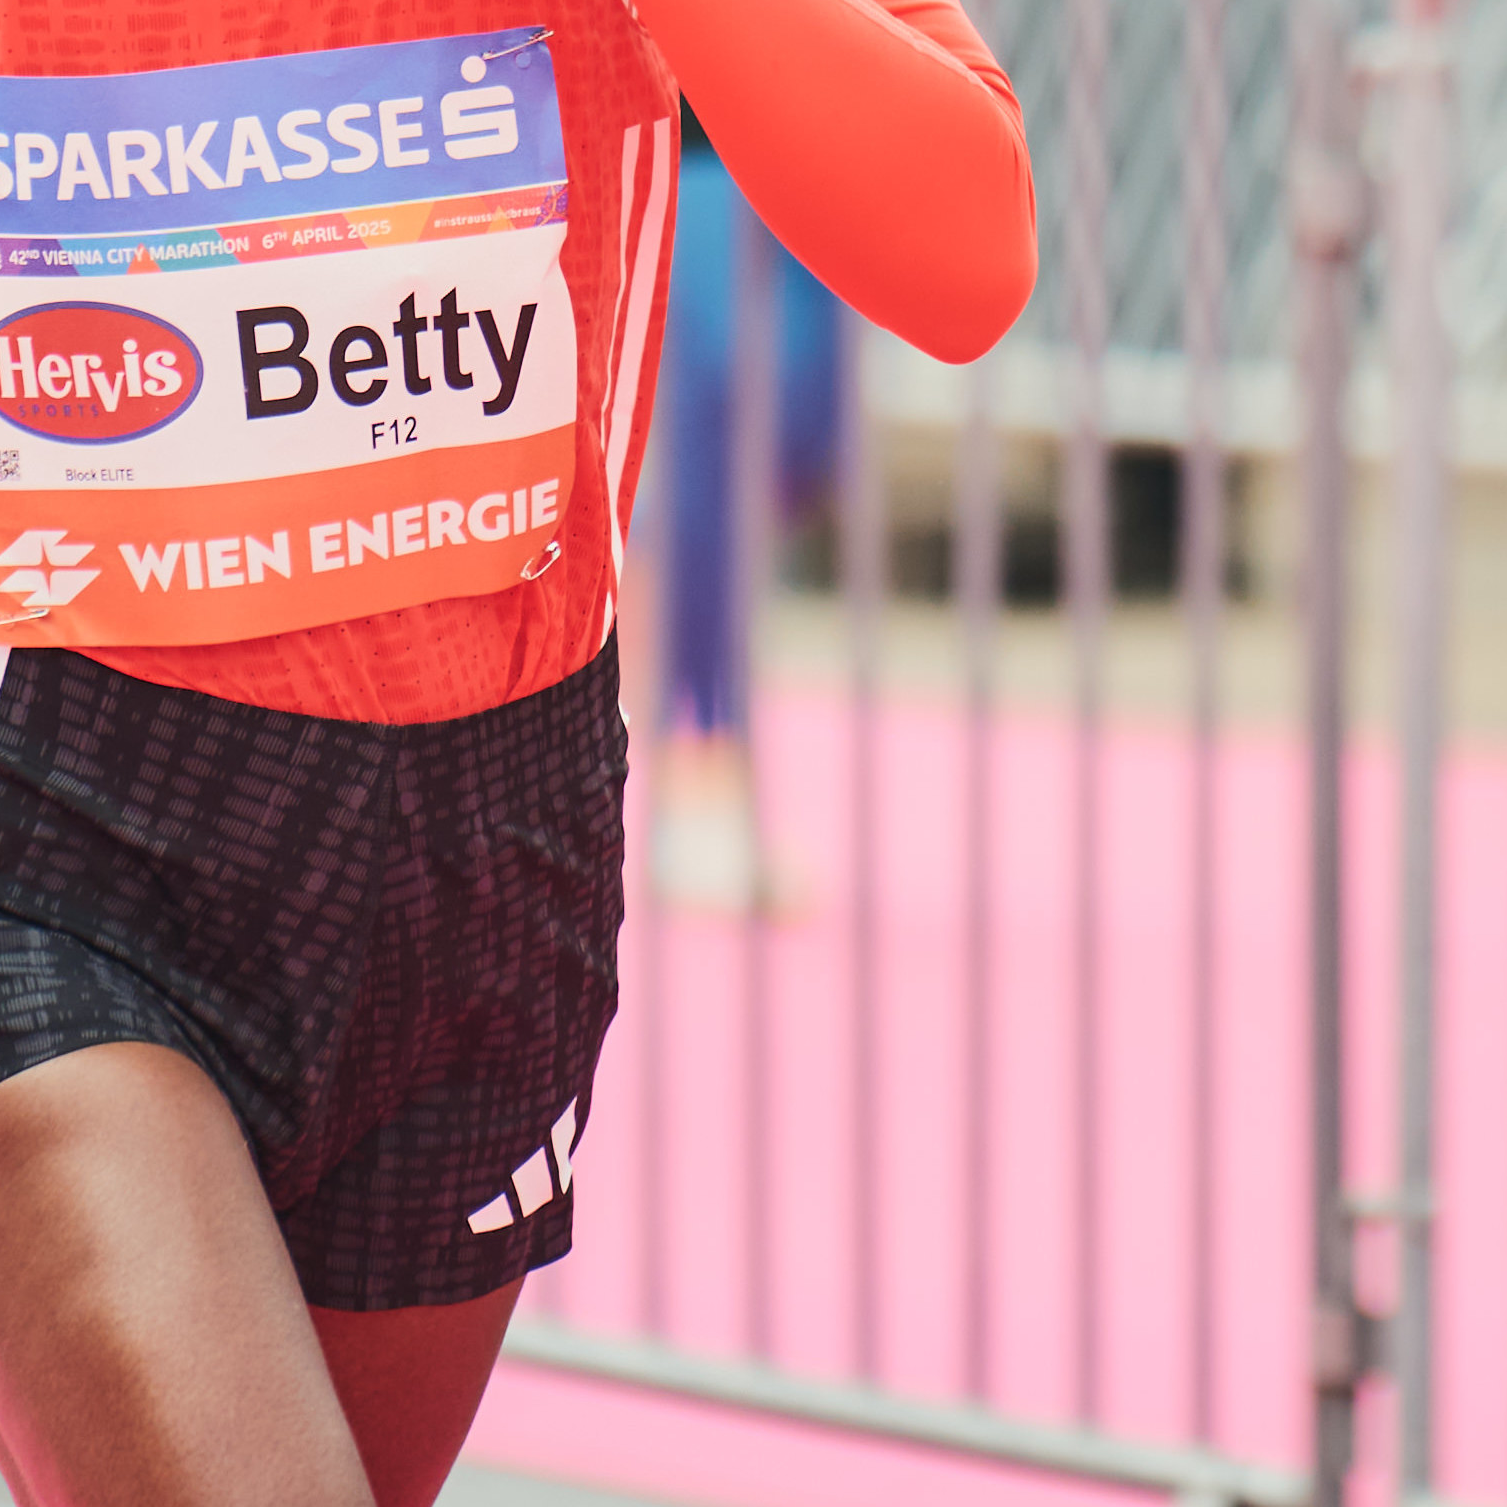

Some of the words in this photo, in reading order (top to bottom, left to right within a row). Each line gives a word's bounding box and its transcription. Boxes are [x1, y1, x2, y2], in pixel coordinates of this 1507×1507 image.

[9, 249, 40, 266] 42ND
[43, 249, 103, 267] VIENNA
[107, 247, 144, 265] CITY
[150, 236, 250, 262] MARATHON
[262, 230, 287, 249] 6TH
[292, 225, 343, 247] APRIL
[347, 220, 391, 240] 2025
[236, 287, 538, 421] Betty
[18, 404, 100, 417] SPORTS
[371, 416, 418, 449] F12
[65, 468, 97, 482] Block
[101, 469, 134, 482] ELITE
[118, 530, 292, 593] WIEN
[309, 478, 560, 574] ENERGIE
